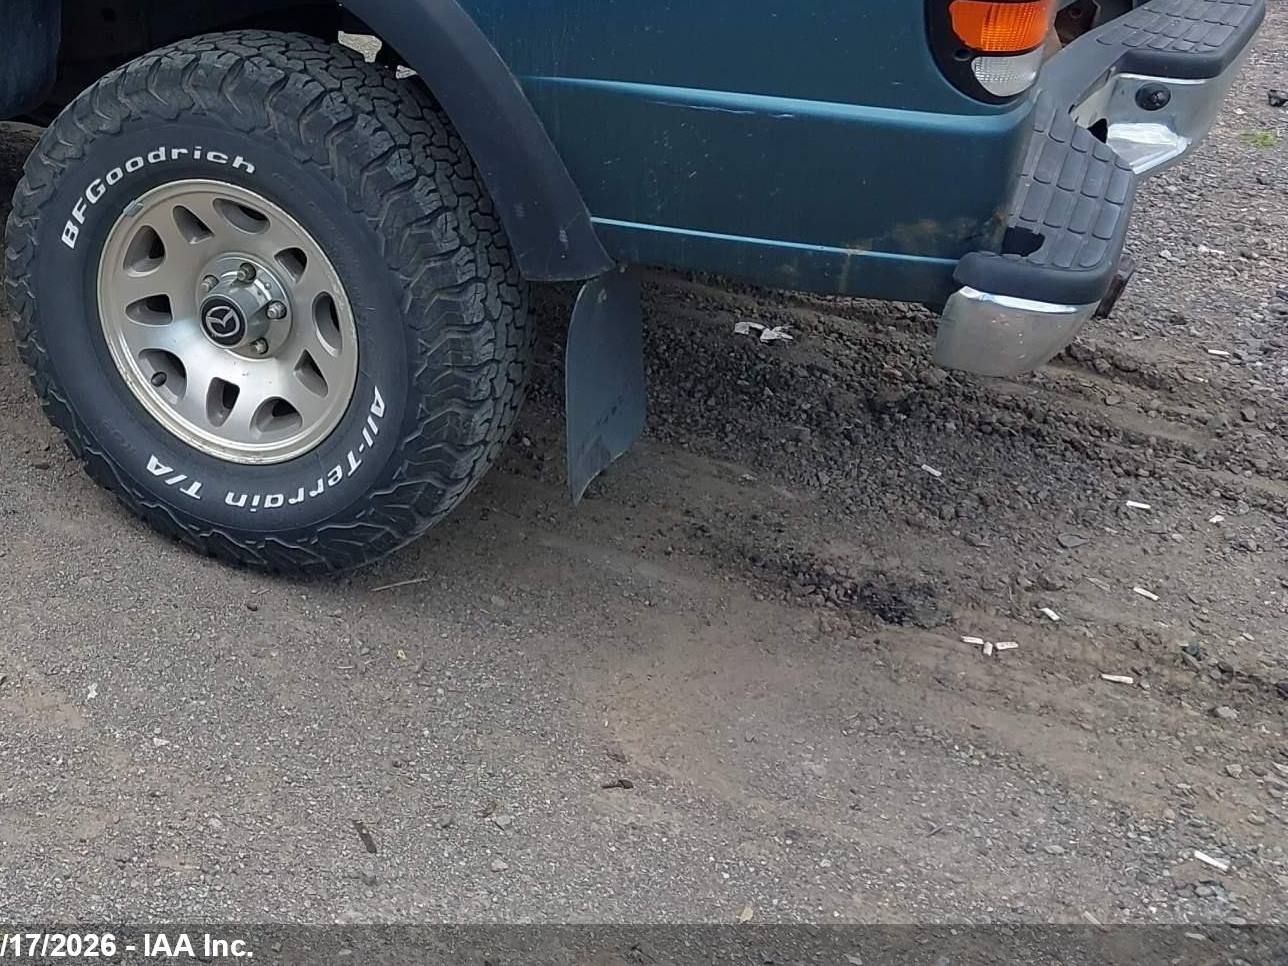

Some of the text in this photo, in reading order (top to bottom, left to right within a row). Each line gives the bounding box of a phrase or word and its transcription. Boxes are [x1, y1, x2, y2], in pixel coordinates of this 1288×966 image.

[61, 145, 257, 250] BFGoodrich
[145, 385, 387, 513] All-Terrain T/A
